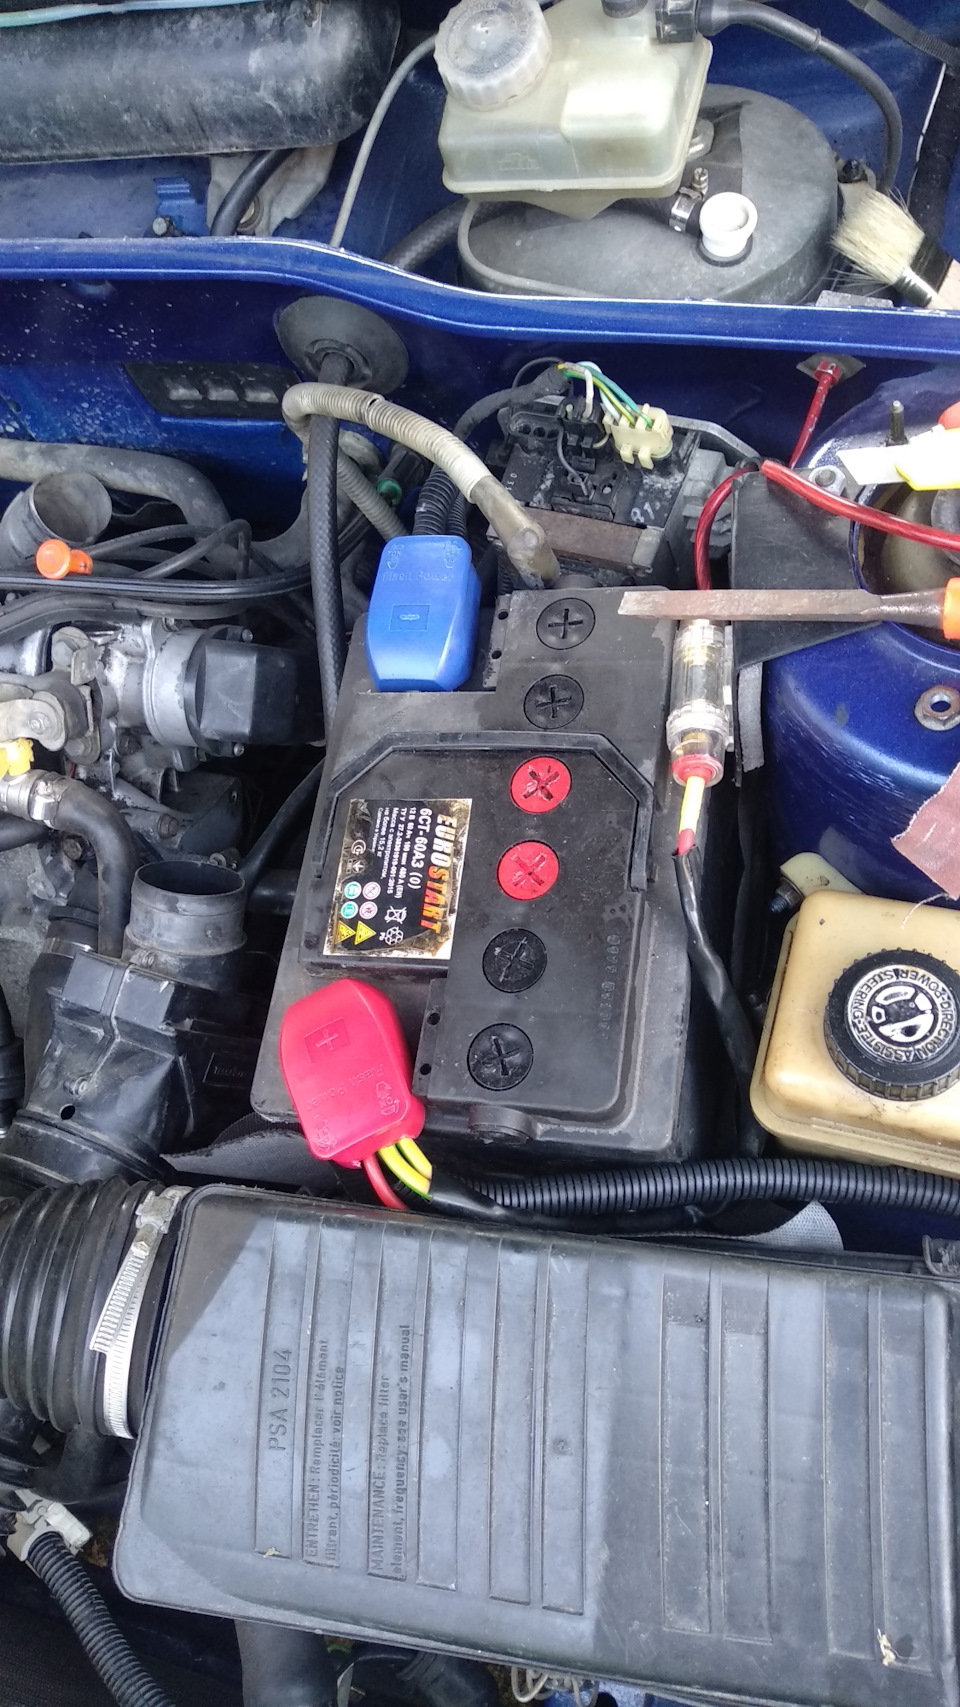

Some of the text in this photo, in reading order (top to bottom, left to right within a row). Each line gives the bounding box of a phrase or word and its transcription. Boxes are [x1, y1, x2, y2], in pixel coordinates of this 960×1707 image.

[419, 815, 456, 934] EUROSTART
[399, 1325, 410, 1371] manual
[268, 1348, 292, 1451] PSA 2104
[332, 1367, 344, 1405] notice
[330, 1410, 341, 1434] voir
